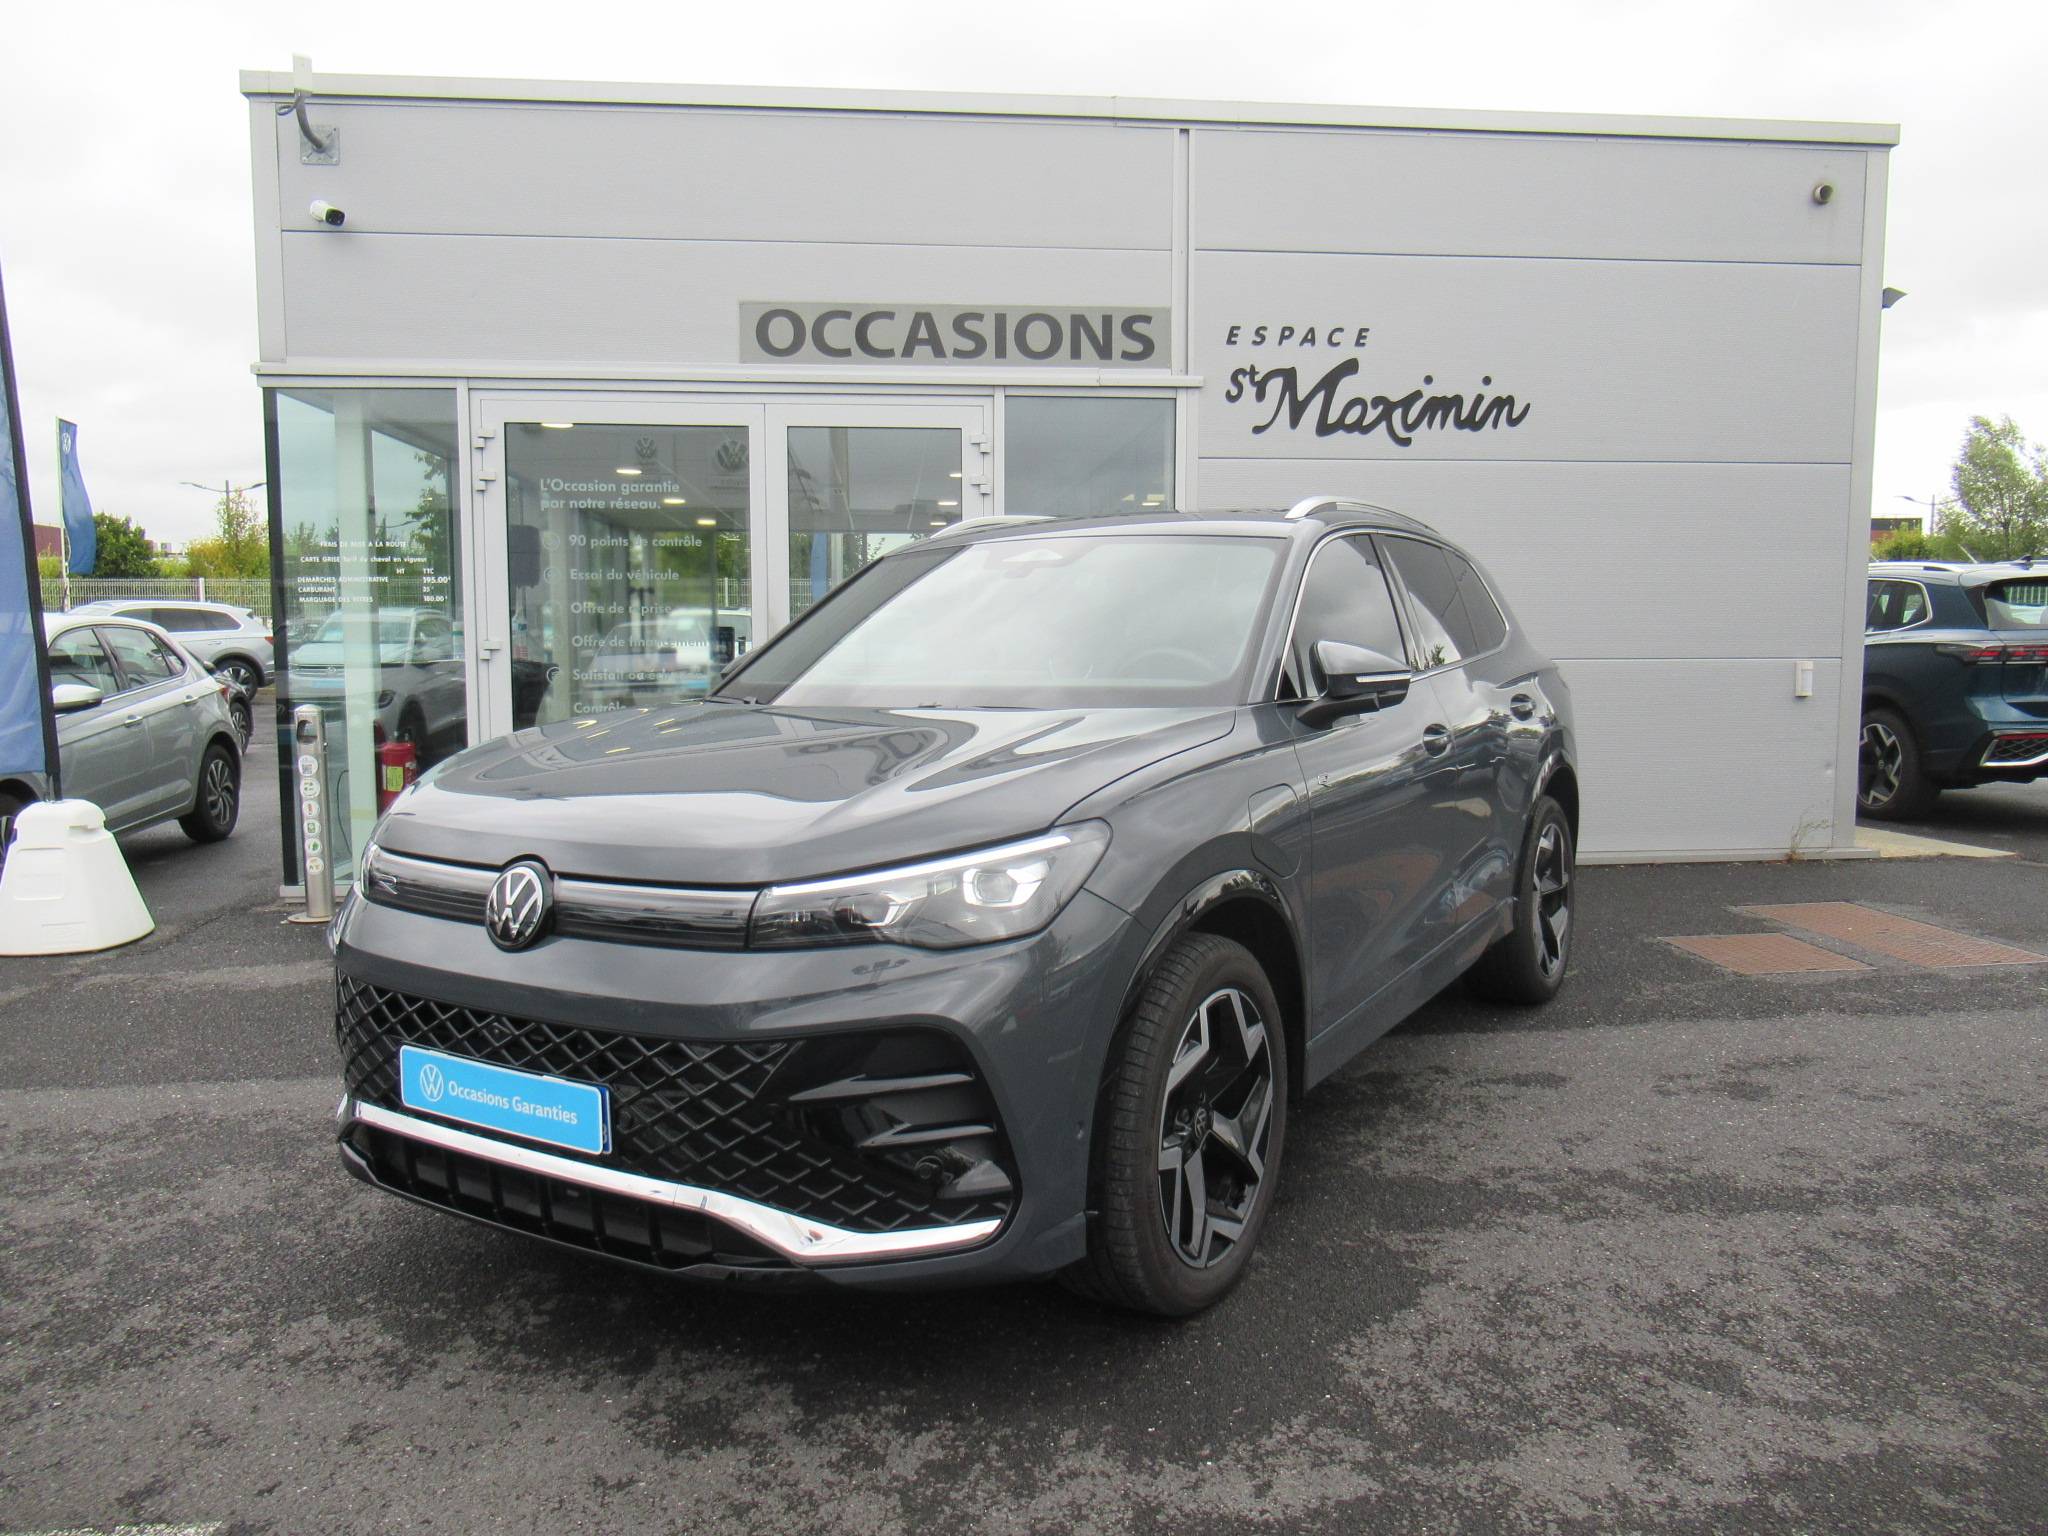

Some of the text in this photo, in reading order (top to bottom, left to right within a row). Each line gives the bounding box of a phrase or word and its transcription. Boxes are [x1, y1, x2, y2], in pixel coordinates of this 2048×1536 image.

[755, 308, 1156, 362] OCCASIONS
[1226, 326, 1370, 347] ESPACE
[1252, 357, 1531, 447] Maximin
[540, 478, 680, 495] L'Occasion garantie
[540, 498, 661, 511] par notre réseau.
[568, 535, 587, 547] 90
[590, 535, 629, 548] points
[652, 535, 703, 547] contrôle
[570, 568, 680, 581] Essai du véhicule
[570, 601, 606, 614] Offre
[608, 601, 625, 614] de
[571, 635, 606, 648] Offre
[608, 635, 625, 648] de
[448, 1080, 578, 1125] Occasions Garanties
